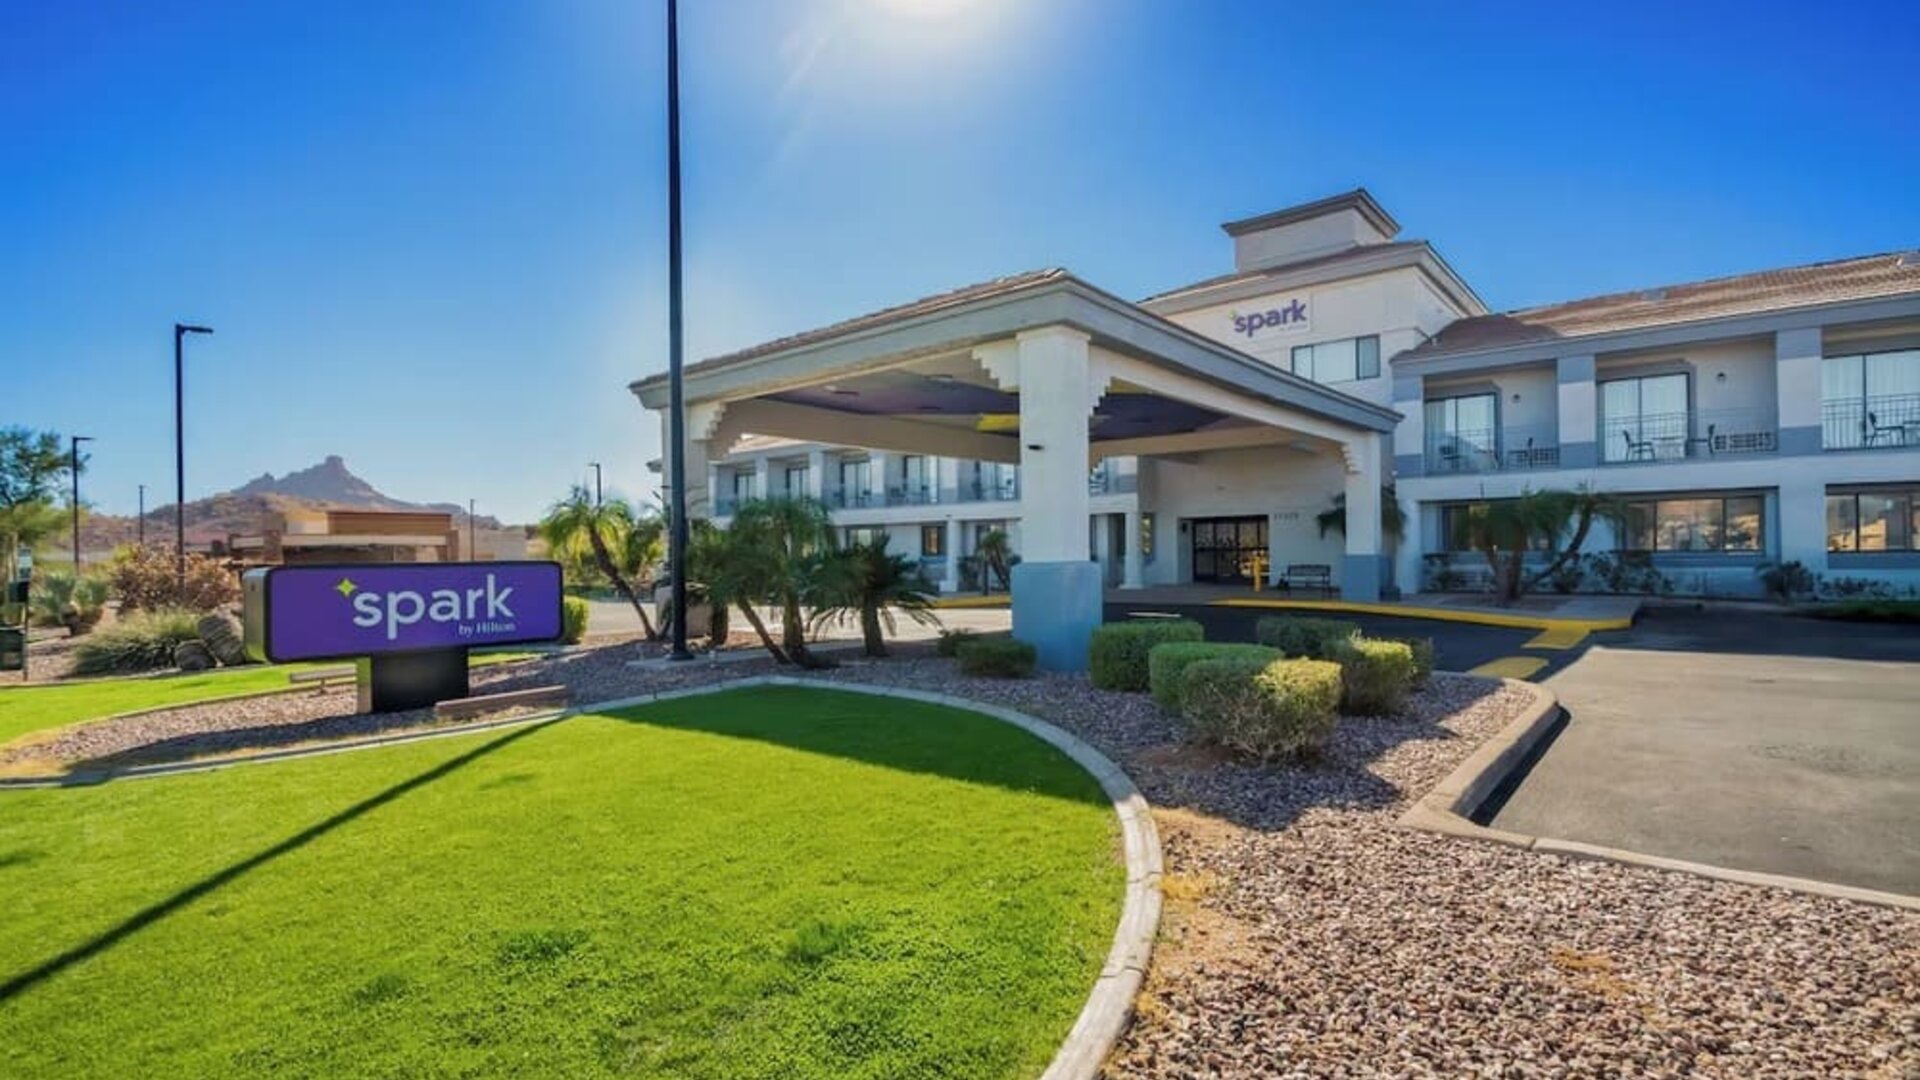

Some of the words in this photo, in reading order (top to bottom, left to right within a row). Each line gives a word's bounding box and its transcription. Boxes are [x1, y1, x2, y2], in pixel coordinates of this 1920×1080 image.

[1234, 299, 1307, 338] spark
[352, 573, 514, 640] spark
[458, 624, 473, 638] by
